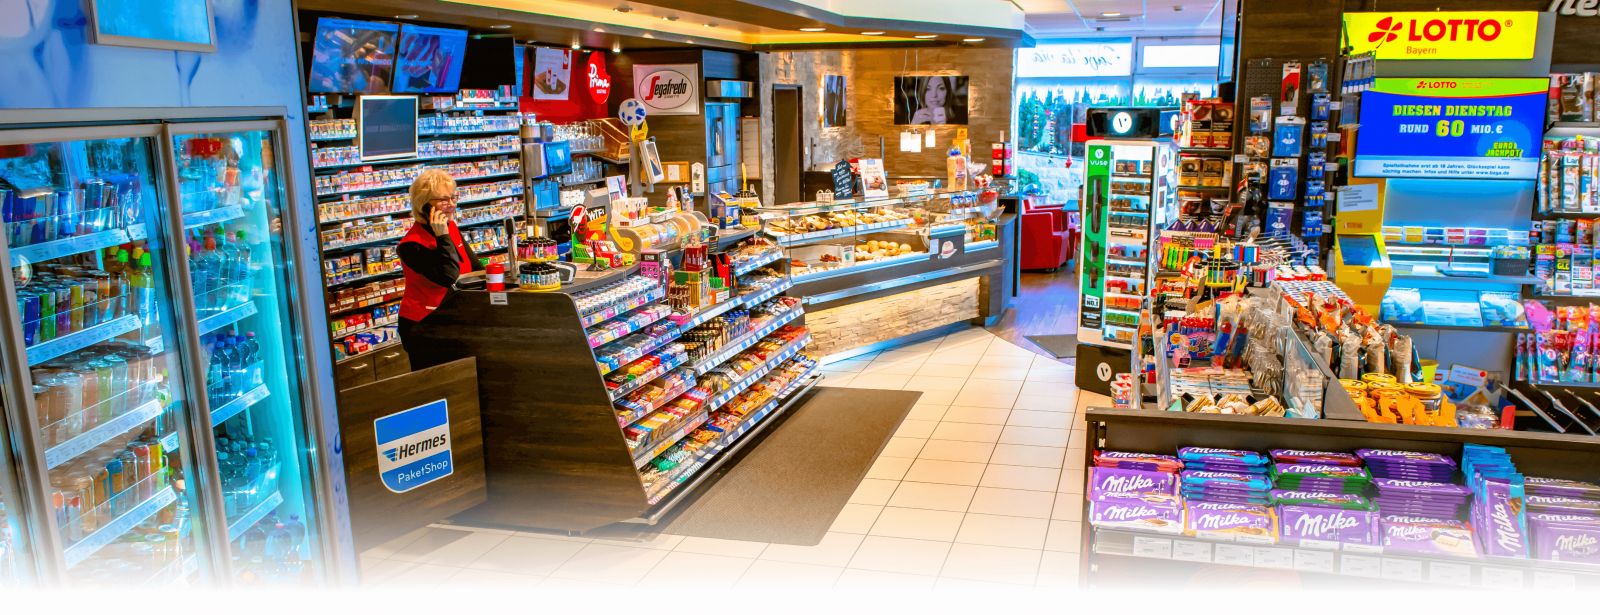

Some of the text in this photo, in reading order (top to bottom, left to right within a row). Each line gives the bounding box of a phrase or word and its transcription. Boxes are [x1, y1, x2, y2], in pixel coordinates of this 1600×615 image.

[1408, 19, 1501, 41] LOTTO
[1406, 46, 1437, 56] Bayern
[645, 76, 687, 100] Segafredo
[1429, 81, 1457, 89] LOTTO
[1392, 105, 1513, 117] DIESEN DIENSTAG
[1399, 124, 1429, 133] RUND
[1436, 120, 1465, 137] 60
[399, 433, 446, 460] Hermes
[397, 460, 448, 484] PaketShop
[1289, 465, 1343, 473] Milka
[1101, 474, 1155, 492] Milka
[1386, 479, 1447, 487] Milka
[1283, 491, 1339, 499] Milka
[1103, 506, 1159, 520] Milka
[1197, 502, 1248, 510] Milka
[1197, 513, 1252, 529] Milka
[1294, 510, 1360, 537] Milka
[1386, 515, 1443, 523] Milka
[1491, 501, 1521, 552] Milka
[1388, 525, 1428, 537] Milka
[1555, 533, 1598, 551] Milka
